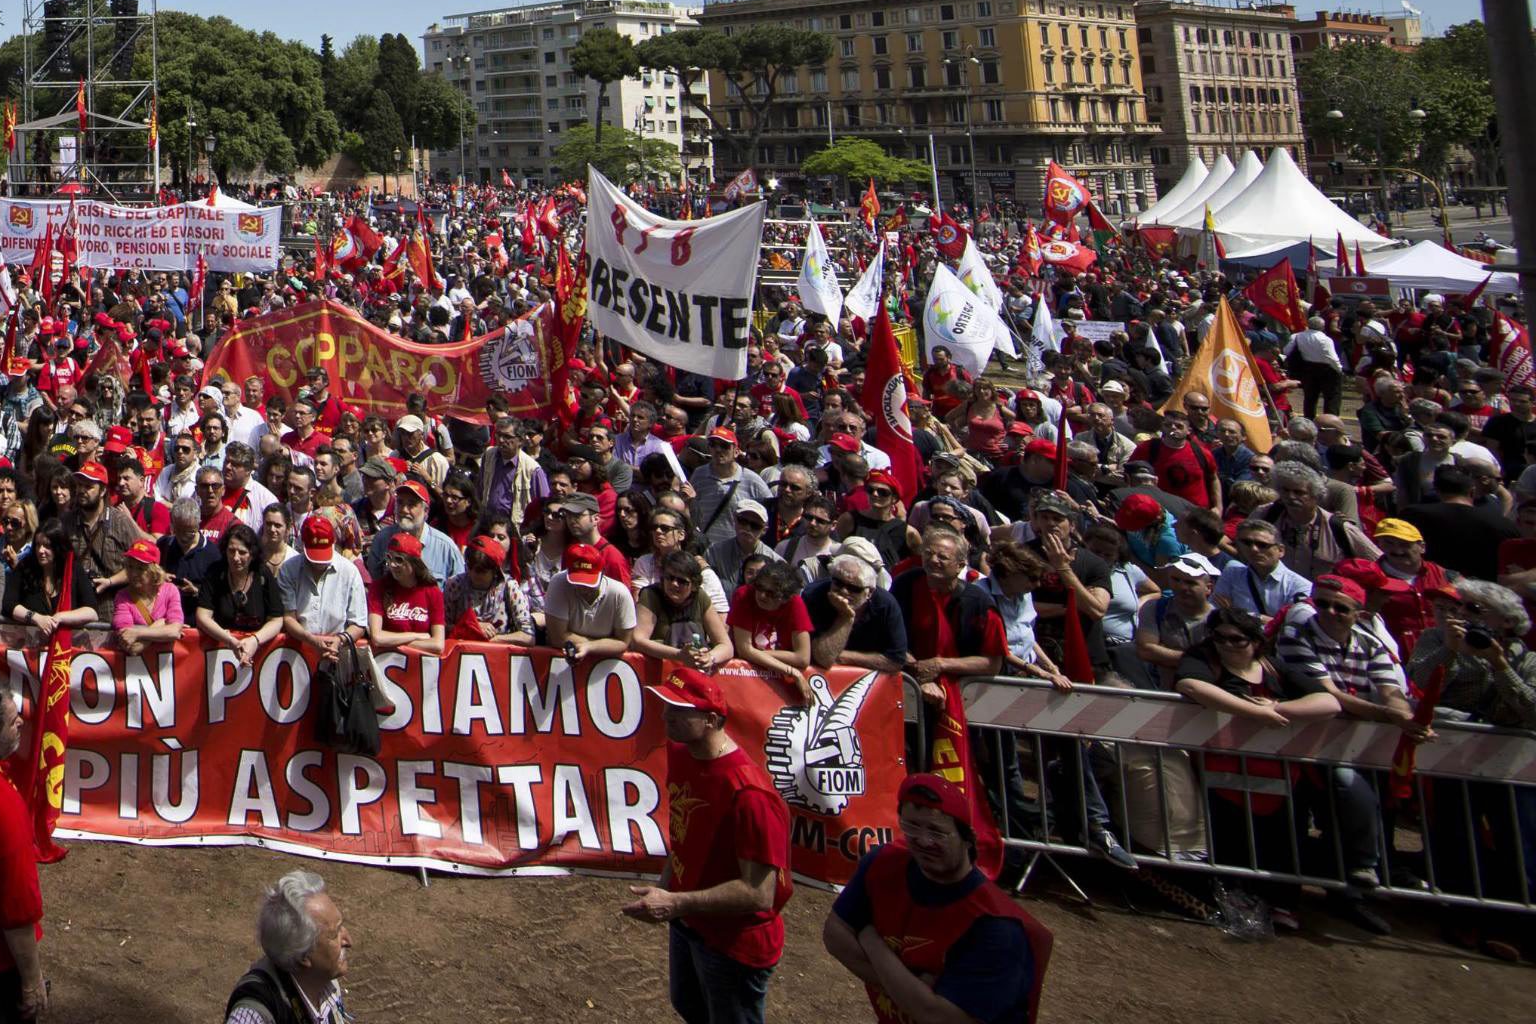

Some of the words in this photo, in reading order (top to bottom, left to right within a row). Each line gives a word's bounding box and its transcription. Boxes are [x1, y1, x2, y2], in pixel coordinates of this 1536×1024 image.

[46, 204, 64, 217] LA
[77, 204, 105, 219] RISI
[125, 206, 152, 220] DEL
[156, 206, 225, 222] CAPITALE
[104, 225, 147, 239] RICCHI
[150, 225, 168, 239] ED
[171, 224, 225, 240] EVASORI
[79, 239, 112, 255] VORO,
[115, 242, 170, 255] PENSIONI
[173, 243, 181, 255] E
[222, 244, 272, 259] SOCIALE
[266, 332, 457, 395] COPPARO
[506, 363, 537, 379] FIOM
[5, 648, 176, 729] NON
[205, 647, 645, 739] POSIAMO
[817, 770, 861, 793] FIOM
[62, 736, 199, 824] PIÙ
[227, 748, 669, 857] ASPETTAR
